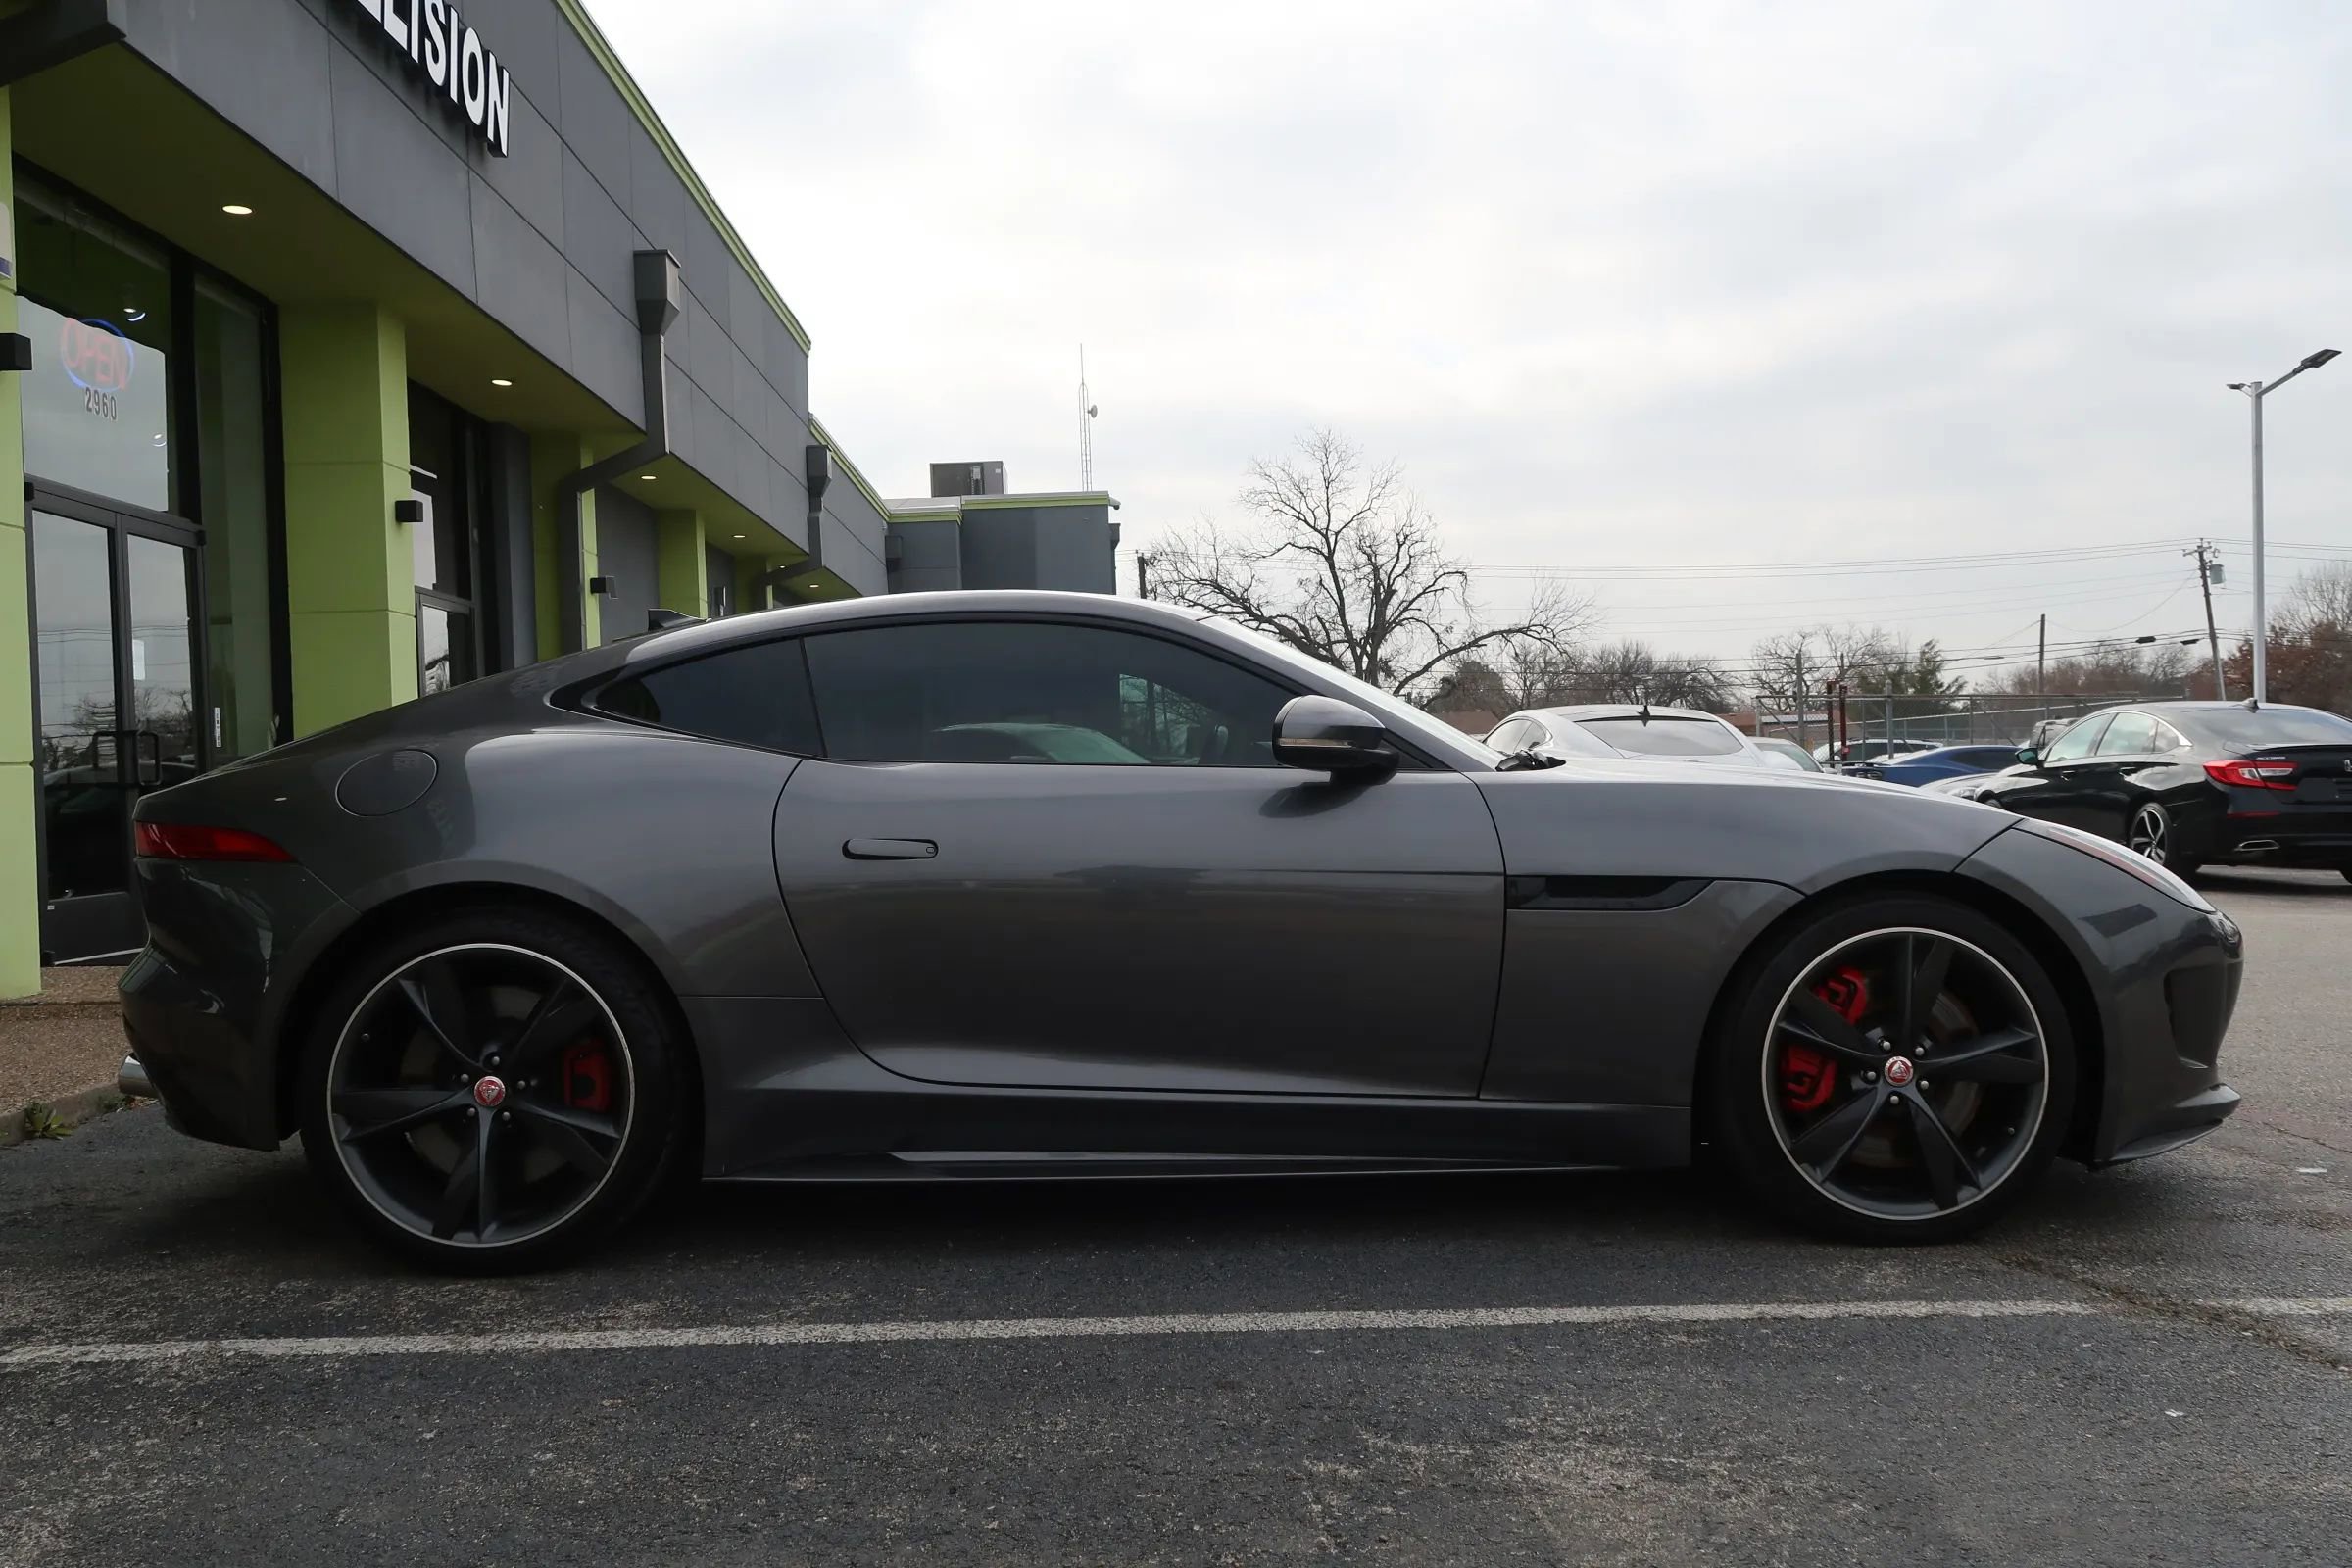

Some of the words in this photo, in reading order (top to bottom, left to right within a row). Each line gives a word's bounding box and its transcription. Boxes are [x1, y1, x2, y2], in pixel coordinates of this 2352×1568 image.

[358, 0, 510, 157] LISION
[61, 318, 126, 390] OPEN
[85, 387, 117, 420] 2960
